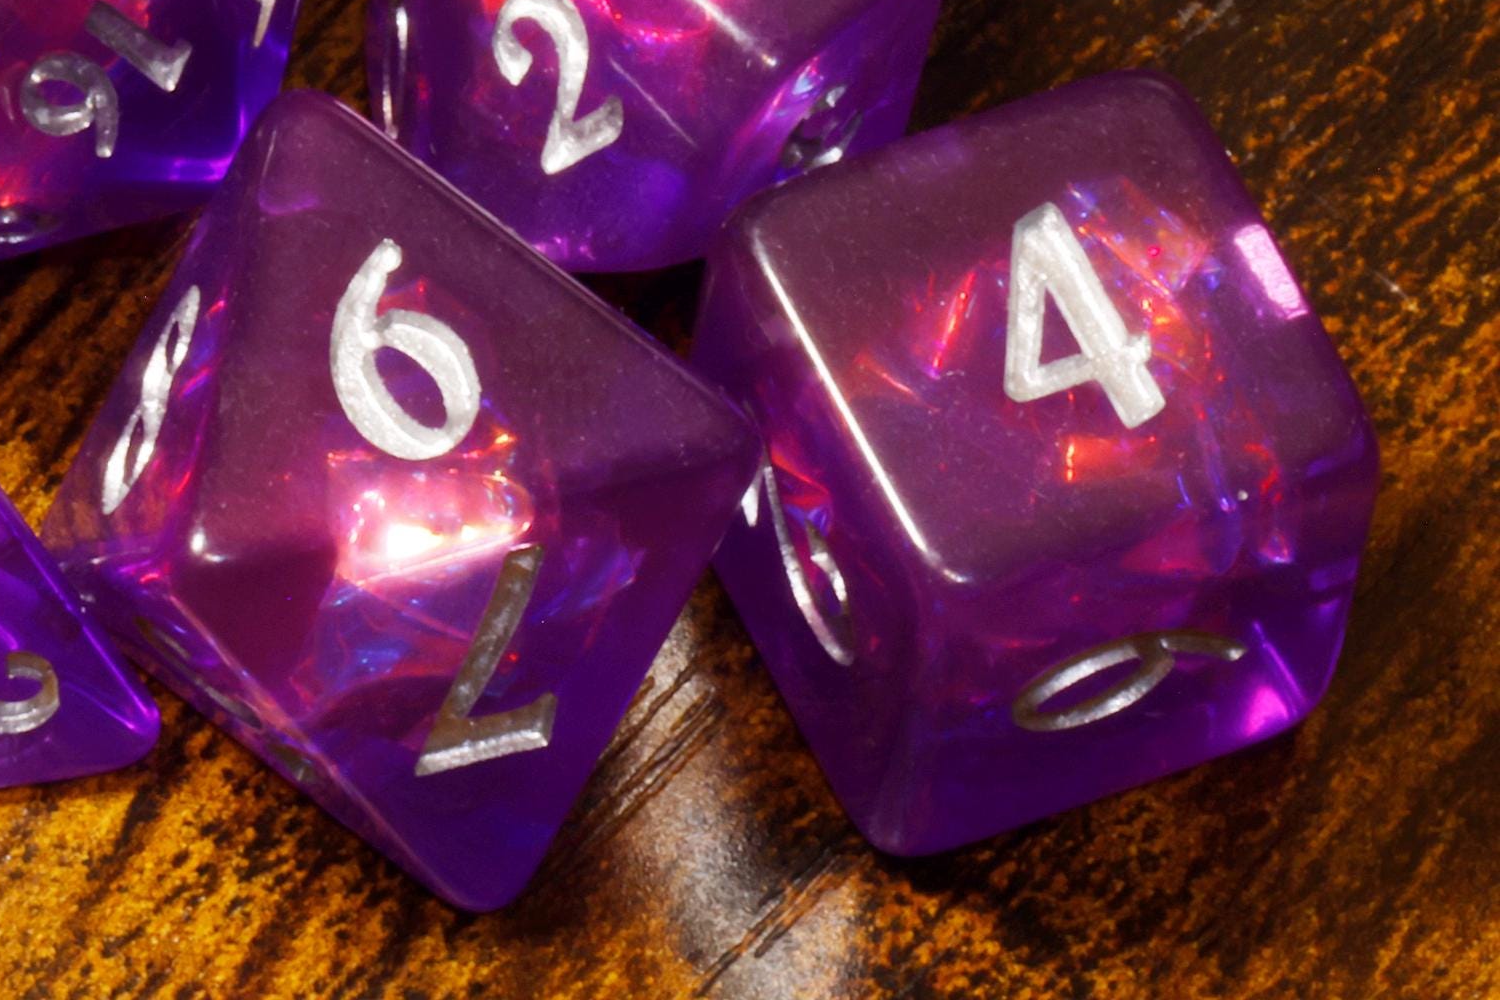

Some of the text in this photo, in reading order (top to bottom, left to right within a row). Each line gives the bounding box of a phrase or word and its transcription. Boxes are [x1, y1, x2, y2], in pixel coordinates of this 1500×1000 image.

[331, 238, 480, 460] 6
[1004, 202, 1166, 428] 4
[416, 546, 557, 777] 7
